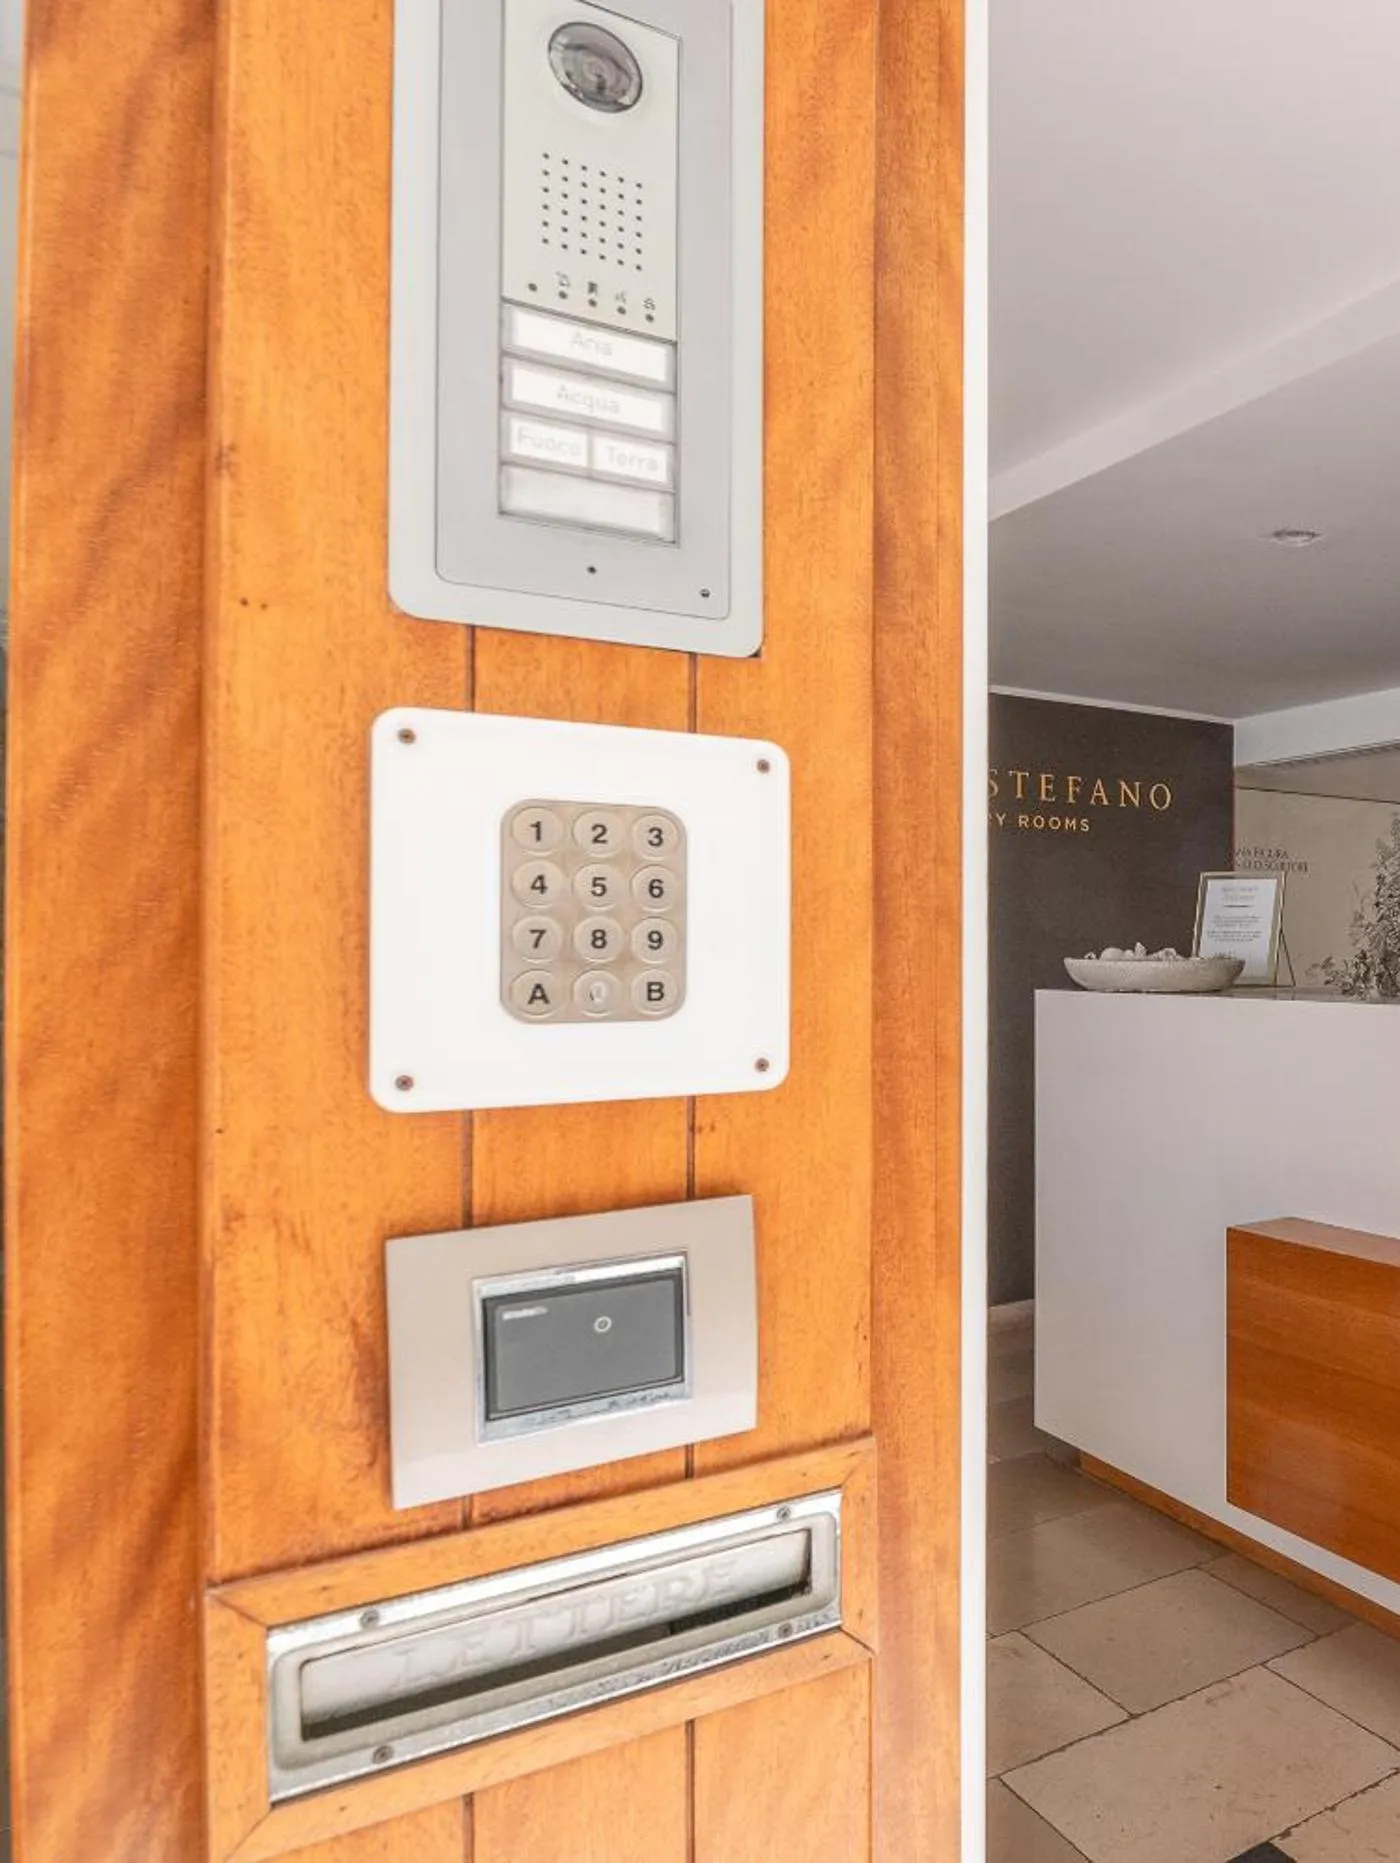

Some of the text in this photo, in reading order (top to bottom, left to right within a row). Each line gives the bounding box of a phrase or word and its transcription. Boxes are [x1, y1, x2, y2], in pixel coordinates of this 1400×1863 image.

[556, 384, 620, 413] Acqua
[605, 445, 659, 471] Terra
[530, 821, 663, 847] 1 2 3
[1018, 815, 1090, 832] ROOMS
[530, 875, 664, 898] 4 5 6
[529, 929, 663, 950] 7 8 9
[528, 984, 550, 1004] A
[647, 982, 664, 1001] B
[392, 1557, 745, 1686] LETTERE
